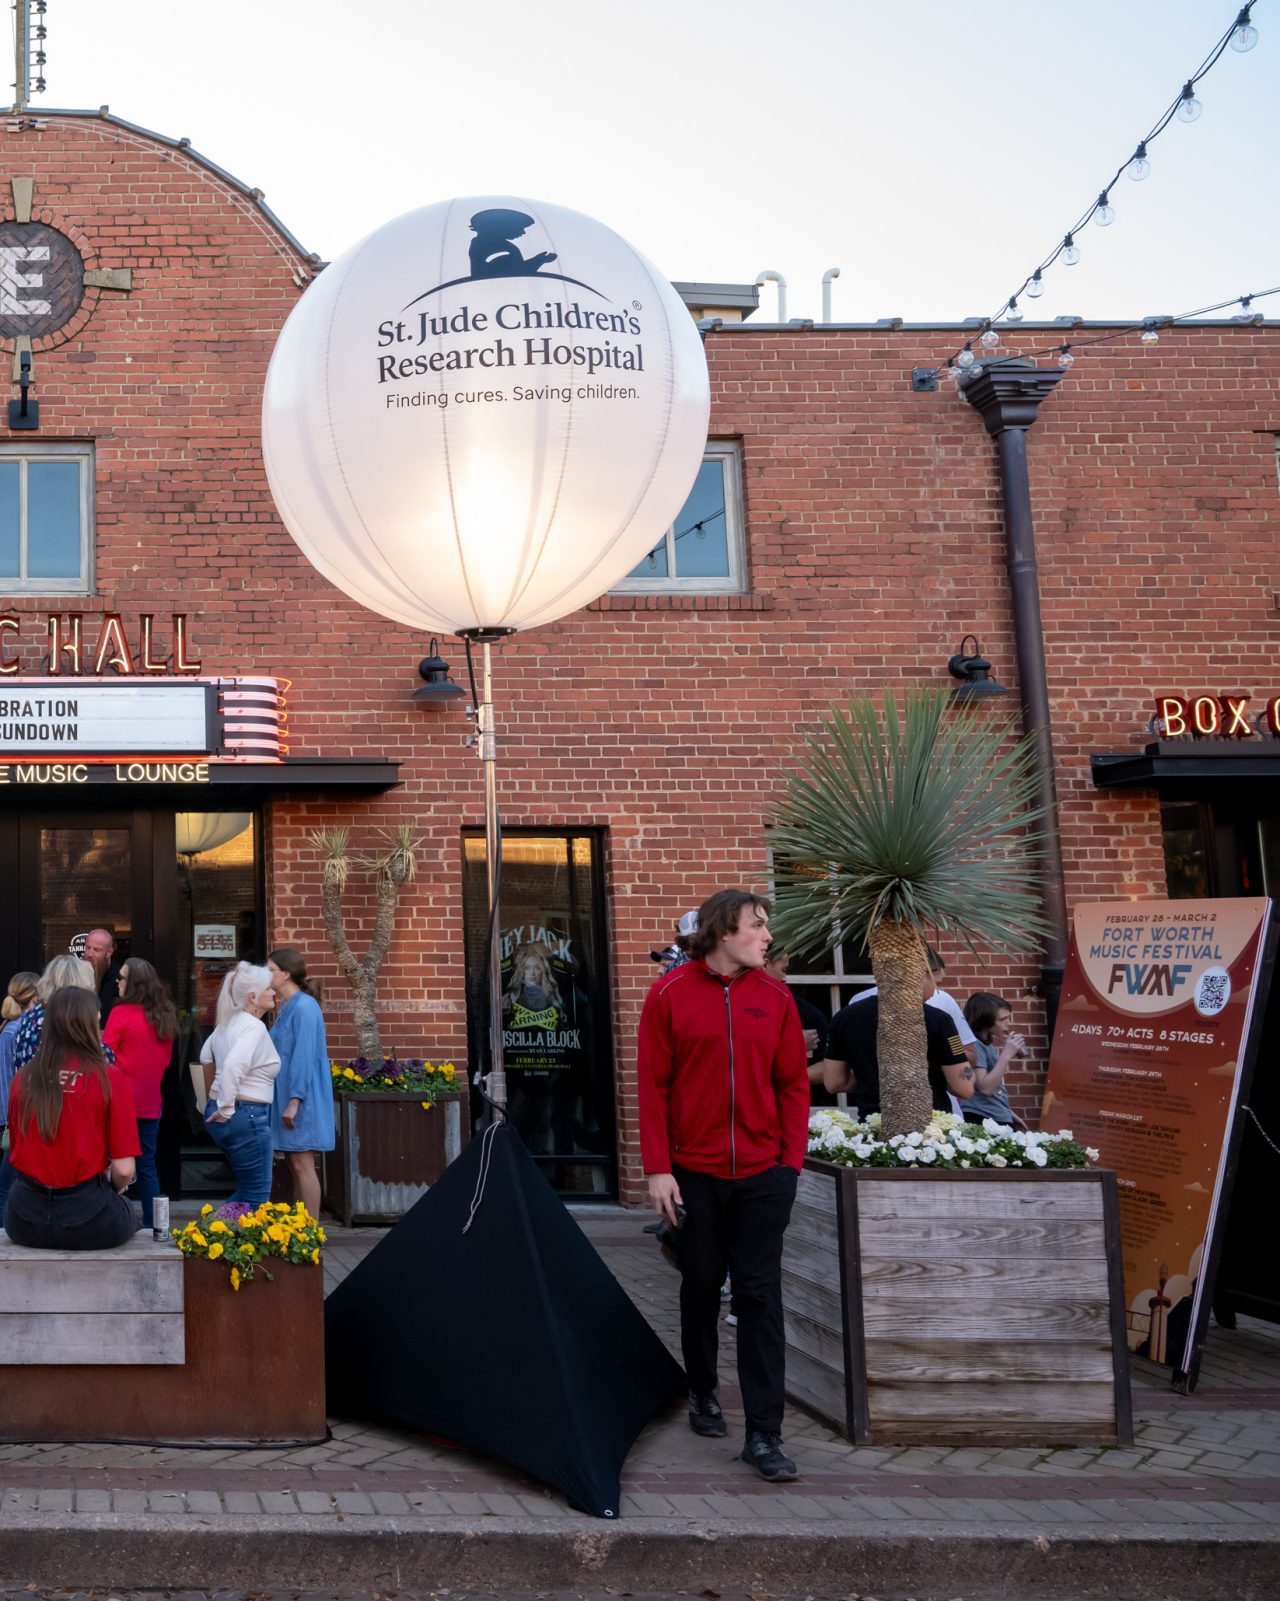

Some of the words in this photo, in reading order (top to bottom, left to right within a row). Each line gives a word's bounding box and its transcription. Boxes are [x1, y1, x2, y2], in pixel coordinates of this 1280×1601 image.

[0, 246, 52, 315] E
[377, 320, 413, 347] St.
[416, 306, 488, 346] Jude
[376, 339, 516, 384] Research
[523, 337, 645, 375] Hospital
[386, 391, 448, 408] Finding
[454, 387, 508, 404] cures.
[512, 385, 572, 404] Saving
[577, 384, 640, 400] children.
[47, 613, 203, 676] HALL
[1156, 696, 1254, 737] BOX
[16, 764, 88, 784] MUSIC
[115, 763, 210, 783] LOUNGE
[1105, 915, 1150, 924] FEBRUARY
[1152, 914, 1163, 923] 28
[1173, 914, 1208, 923] MARCH
[1210, 913, 1217, 921] 2
[527, 925, 572, 962] JACK
[1102, 927, 1144, 942] FORT
[1151, 926, 1215, 942] WORTH
[1089, 944, 1138, 959] MUSIC
[1142, 944, 1223, 960] FESTIVAL
[1108, 963, 1193, 996] FWMF
[546, 1028, 581, 1049] BLOCK
[1071, 1024, 1078, 1034] 4
[1079, 1025, 1102, 1036] DAYS
[1107, 1026, 1125, 1037] 70+
[1126, 1027, 1154, 1039] ACTS
[1159, 1030, 1167, 1040] 8
[1168, 1030, 1214, 1044] STAGES
